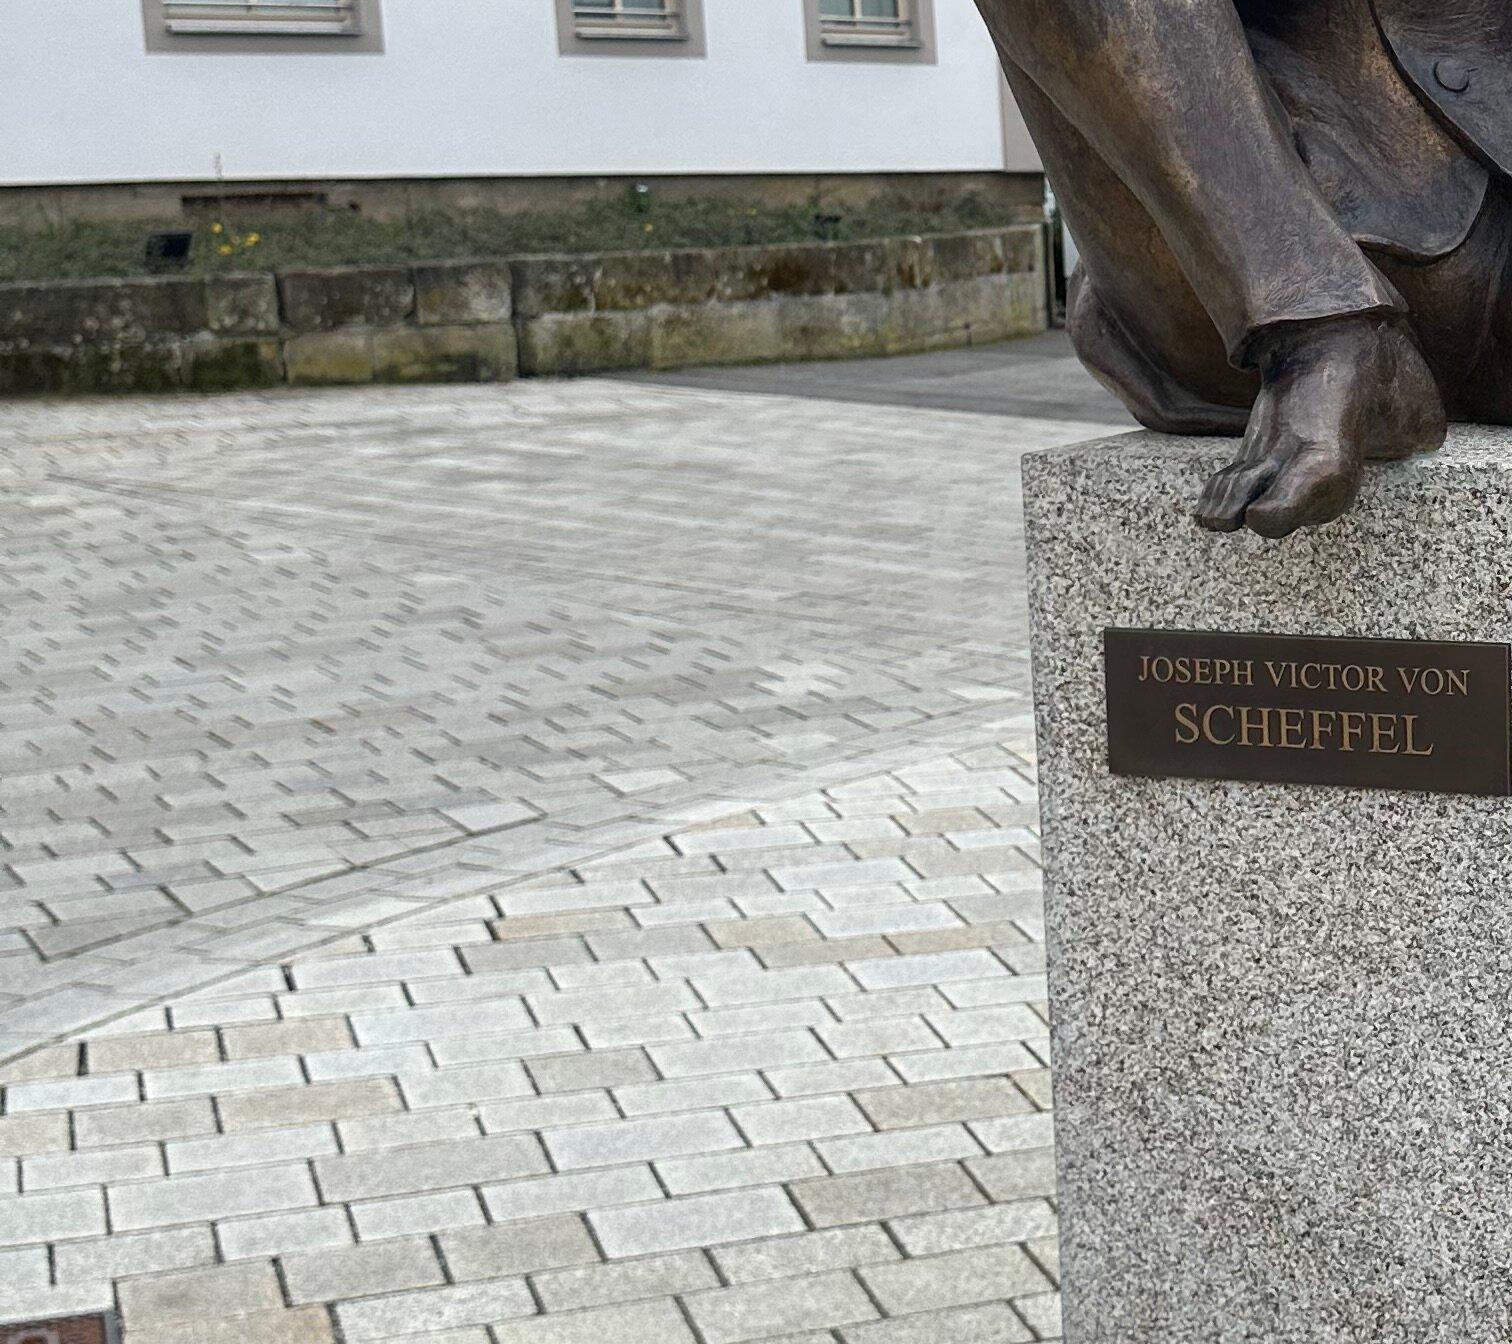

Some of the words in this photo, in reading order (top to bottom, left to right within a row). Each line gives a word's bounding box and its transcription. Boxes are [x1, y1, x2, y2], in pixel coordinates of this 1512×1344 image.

[1138, 655, 1254, 686] JOSEPH
[1264, 660, 1389, 693] VICTOR
[1396, 667, 1471, 696] VON
[1174, 702, 1435, 756] SCHEFFEL
